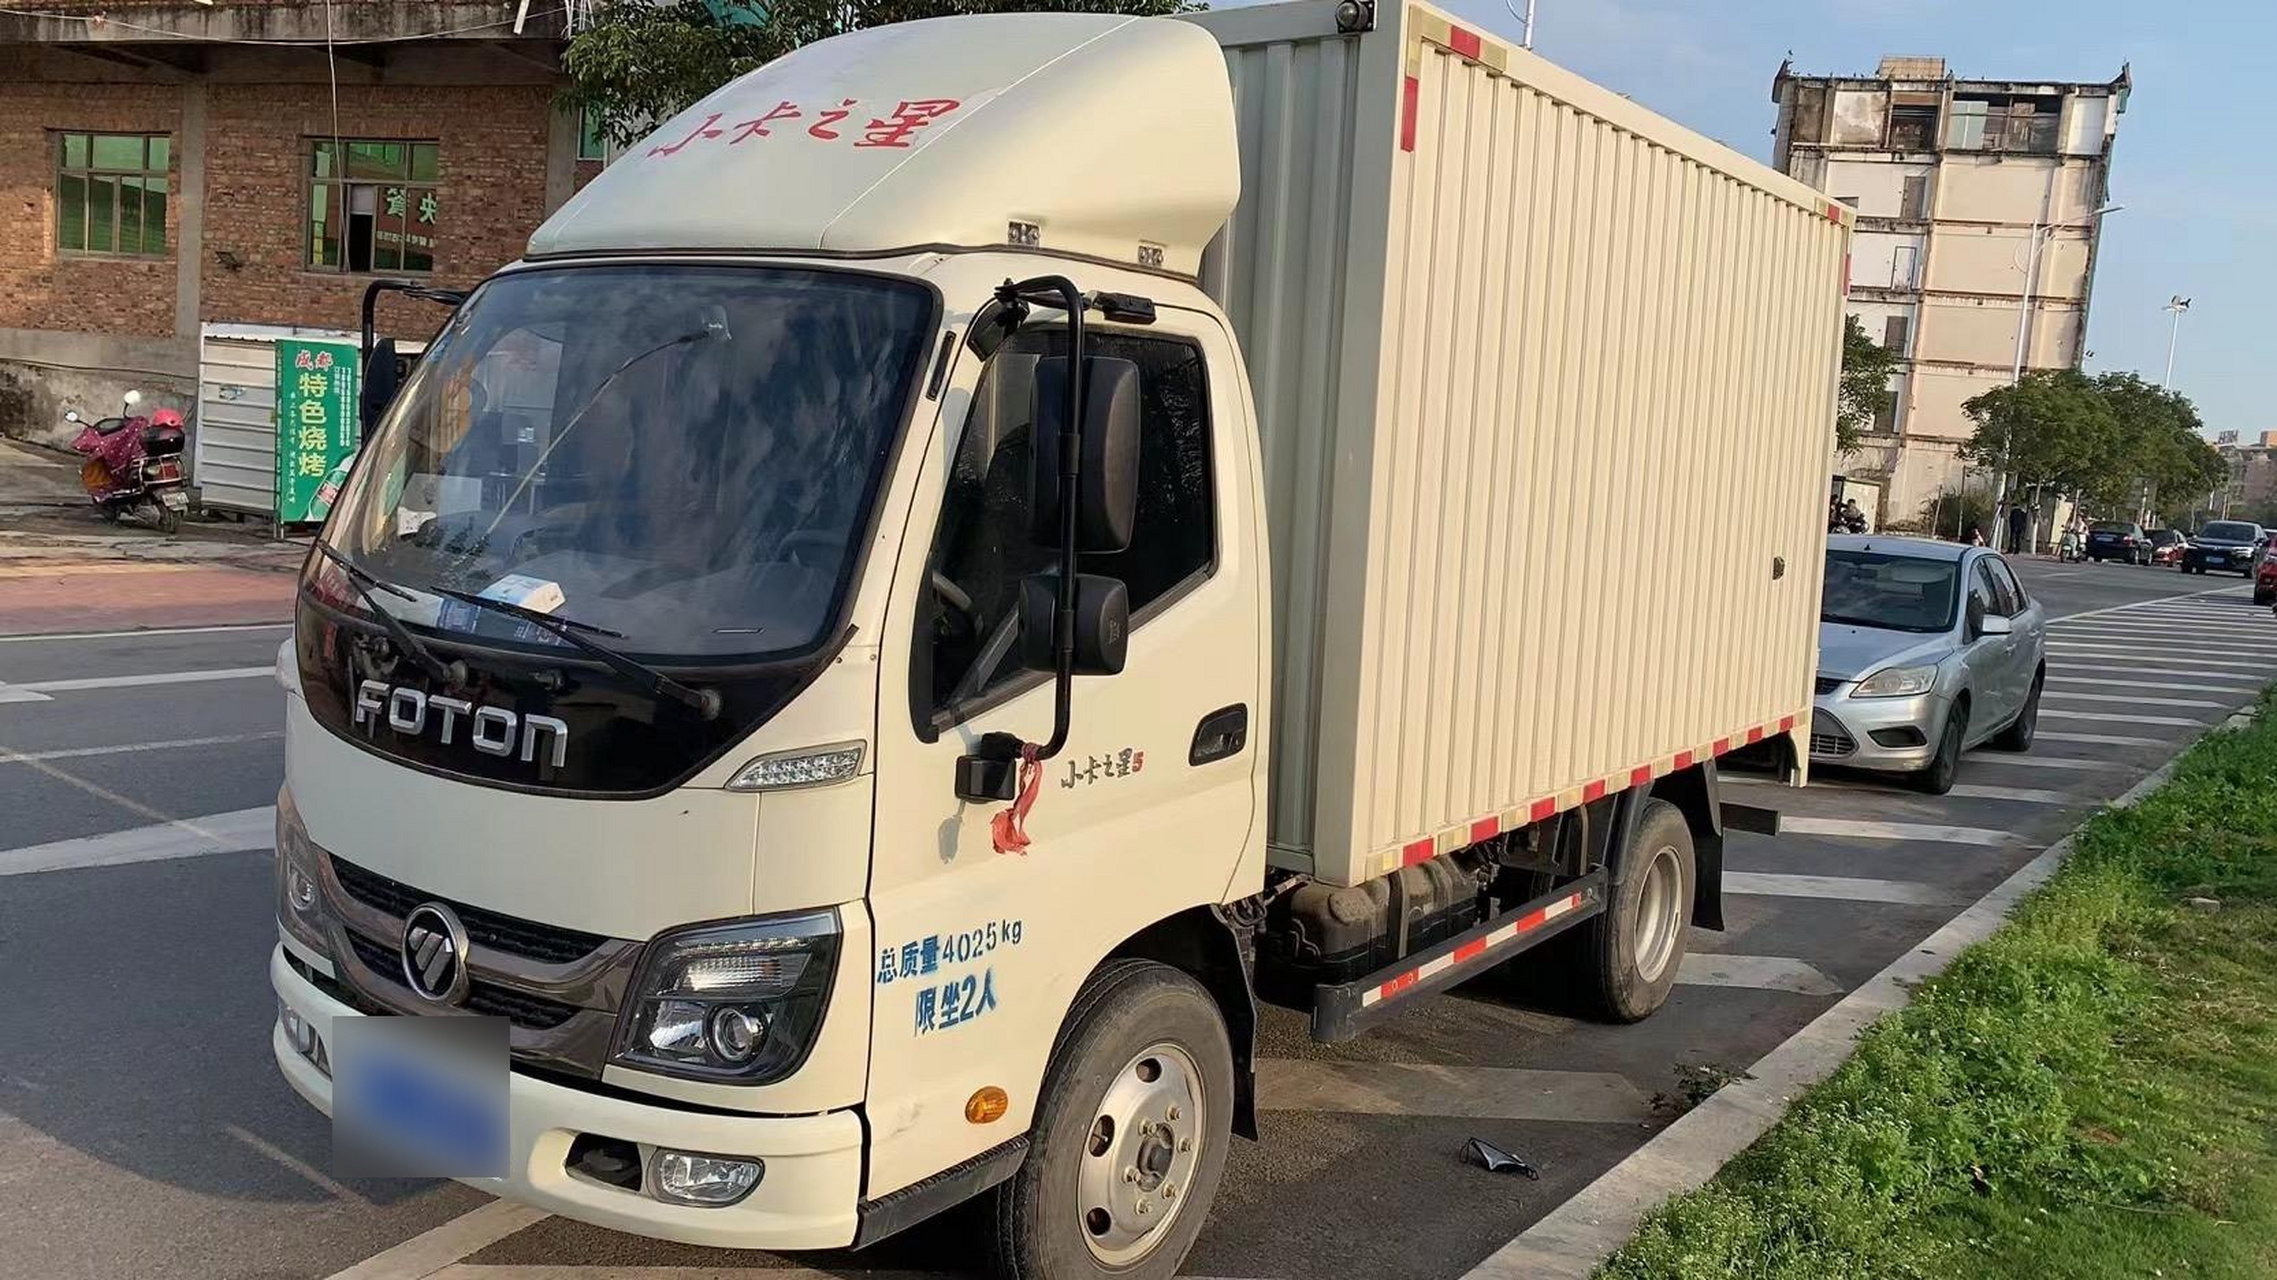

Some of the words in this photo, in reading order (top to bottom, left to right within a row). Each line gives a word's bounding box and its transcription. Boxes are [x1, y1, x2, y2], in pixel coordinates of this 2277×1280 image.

[298, 372, 328, 477] 特色烧烤
[355, 679, 568, 768] FOTON
[914, 966, 997, 1037] 限坐2人
